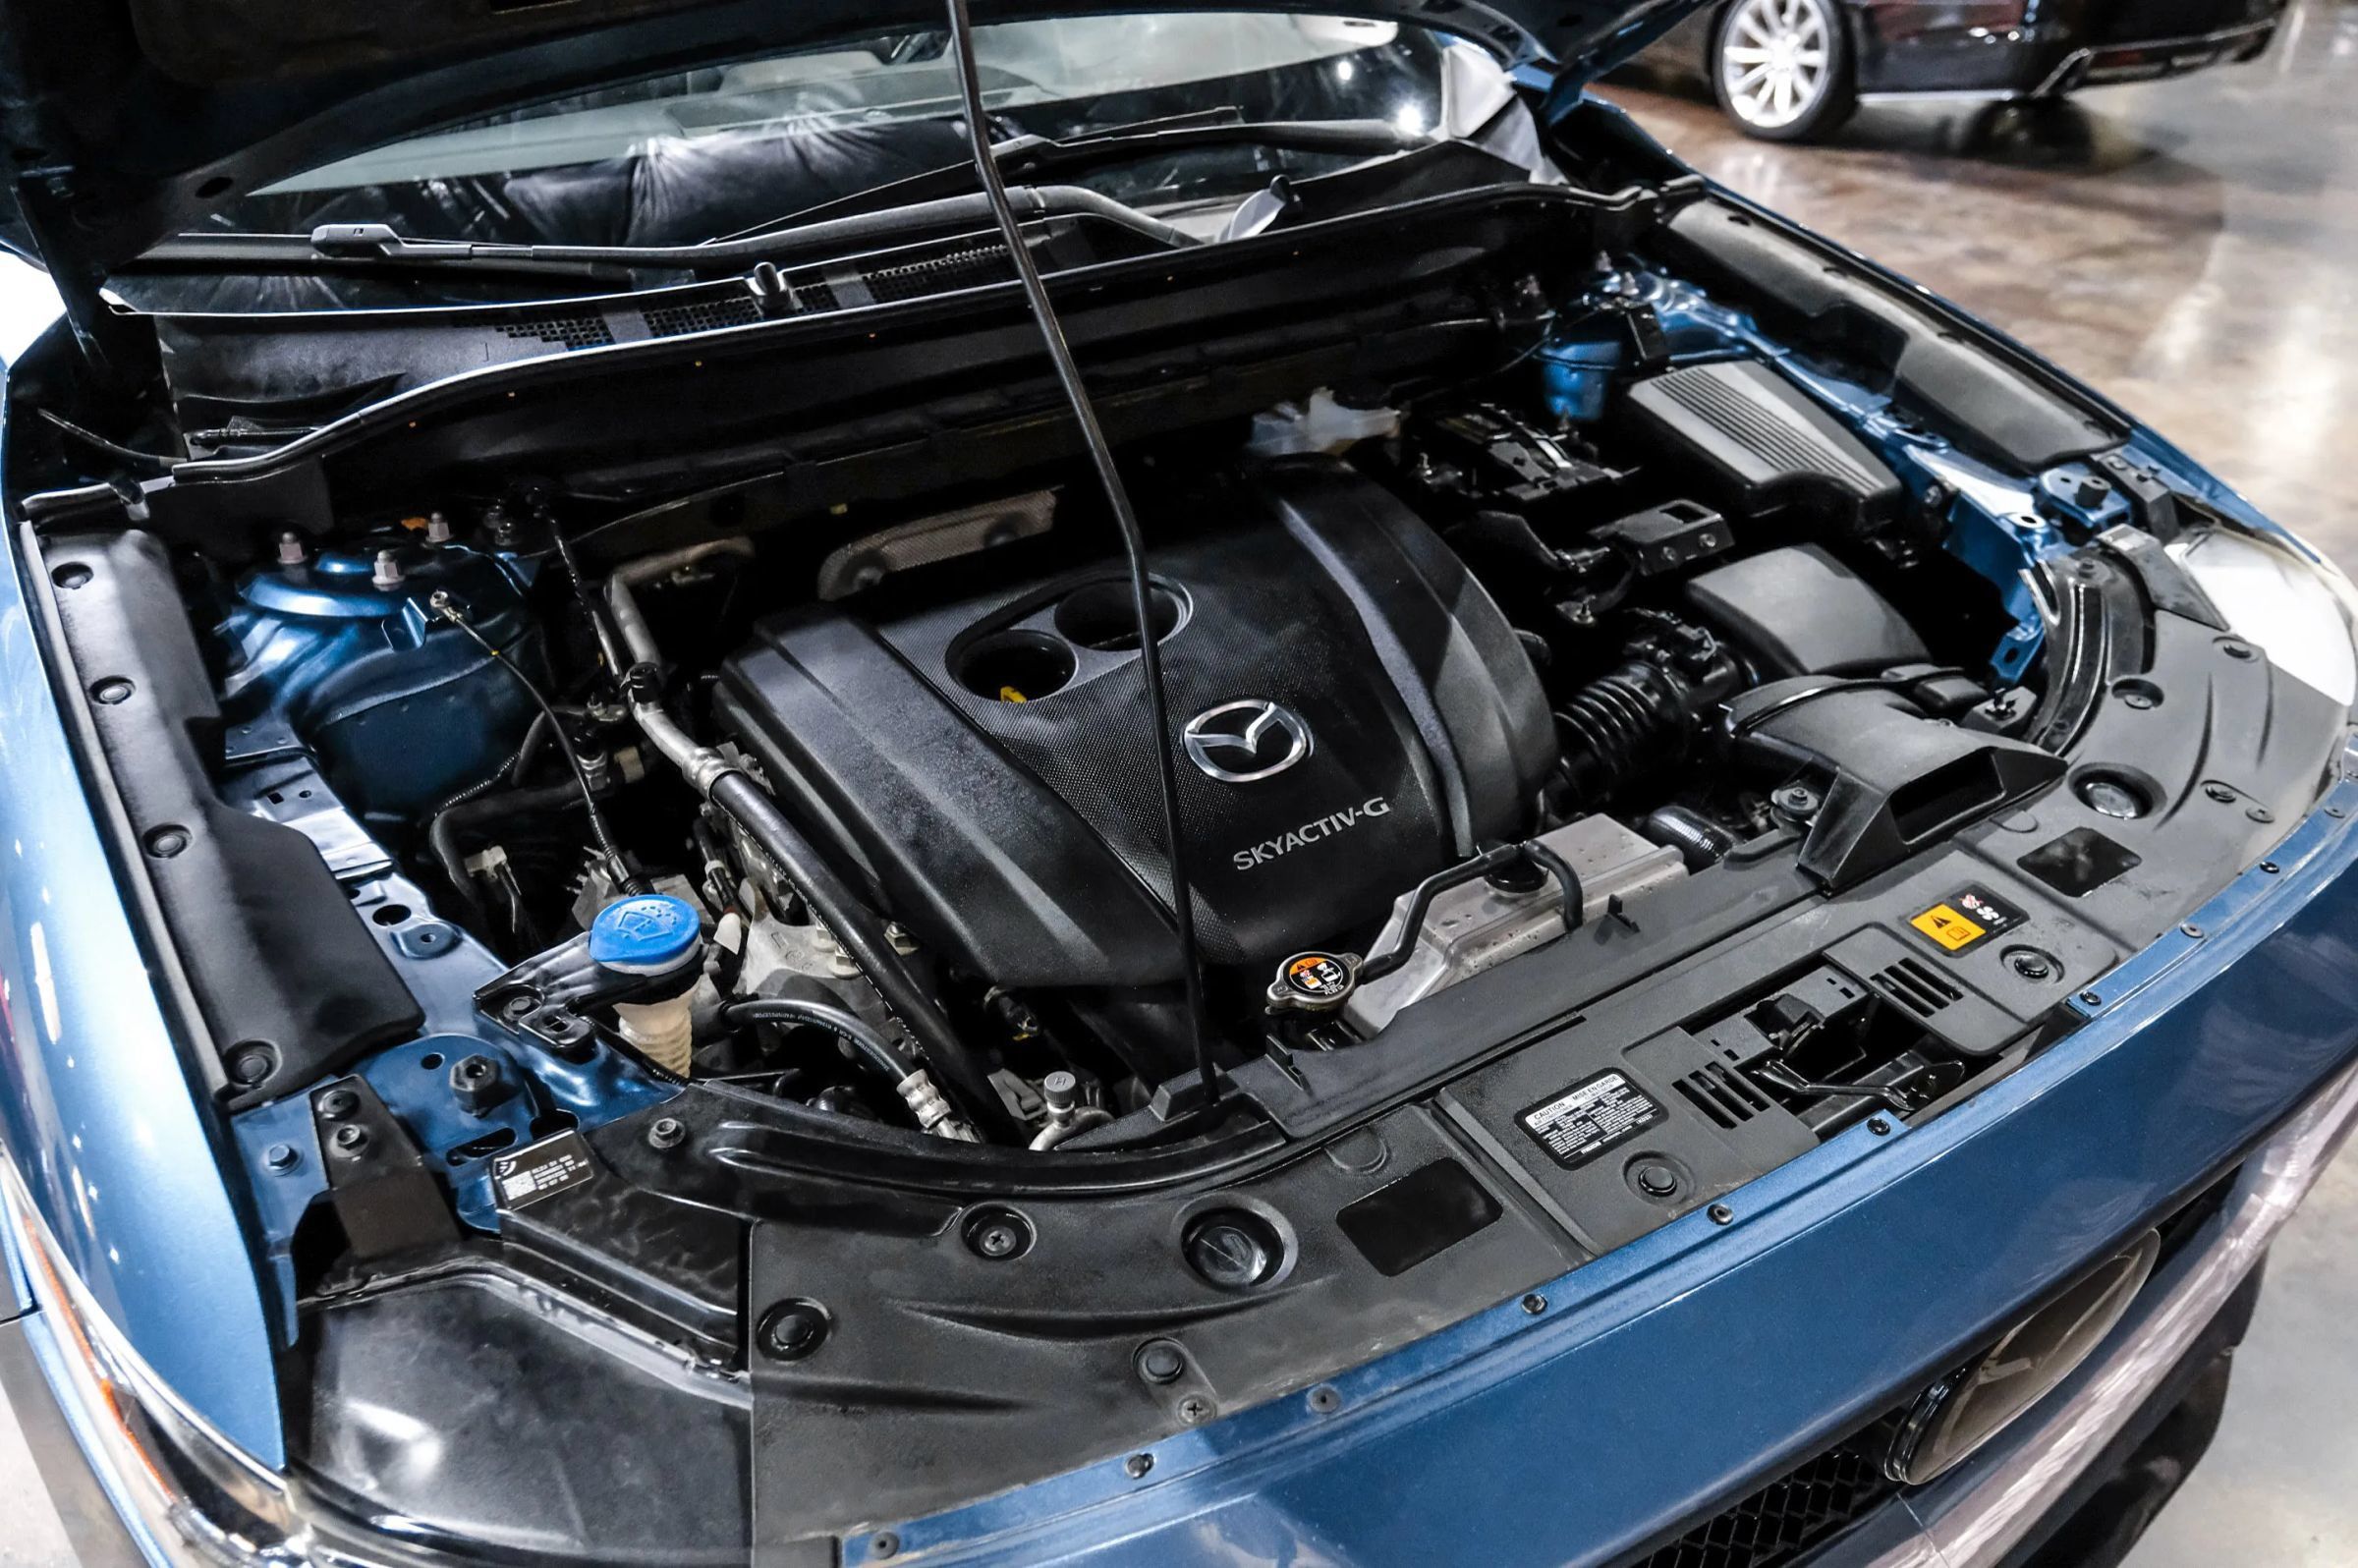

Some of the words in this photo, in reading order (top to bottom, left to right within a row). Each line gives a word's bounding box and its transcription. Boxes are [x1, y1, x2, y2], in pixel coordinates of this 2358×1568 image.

[1233, 797, 1390, 870] SKYACTIV-G
[1572, 1091, 1588, 1100] MISE
[1587, 1085, 1598, 1093] EN
[1596, 1076, 1618, 1090] GARDE
[1534, 1101, 1565, 1120] CAUTION
